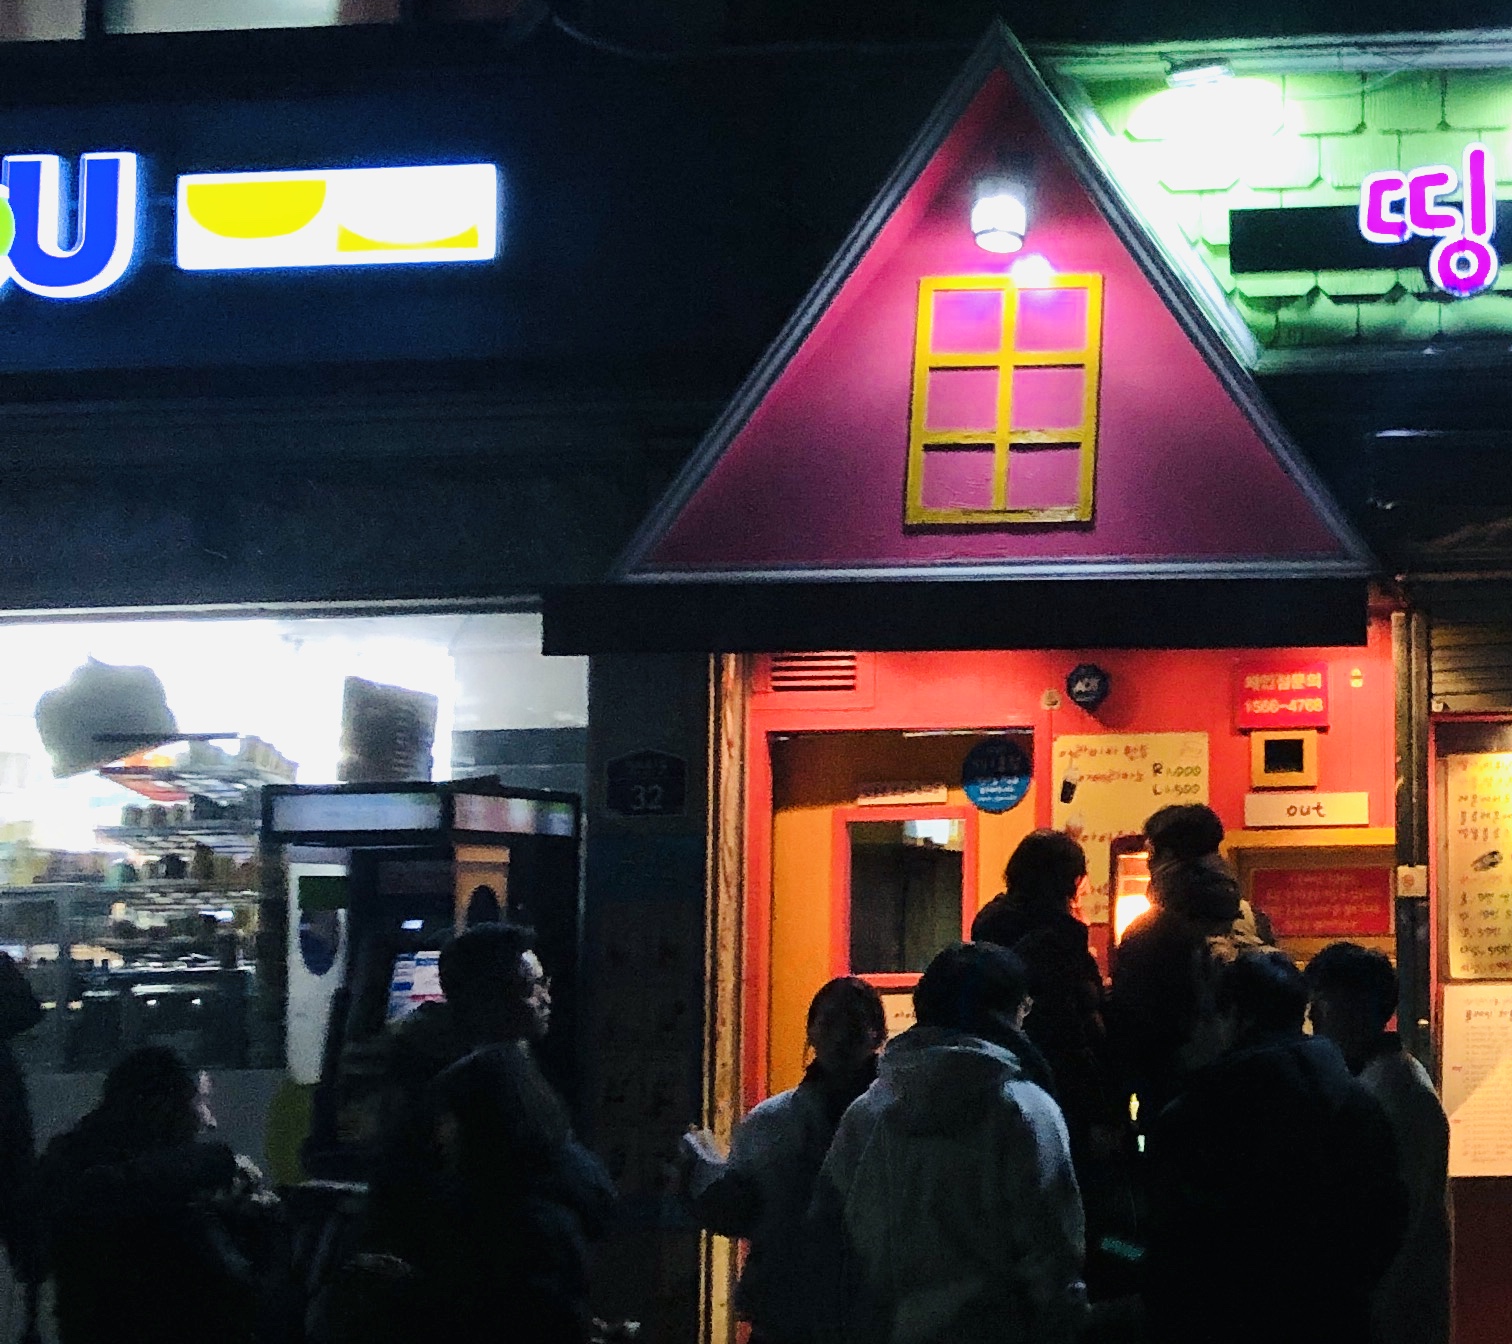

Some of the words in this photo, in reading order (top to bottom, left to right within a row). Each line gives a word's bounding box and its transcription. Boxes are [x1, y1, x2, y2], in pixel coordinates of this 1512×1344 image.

[0, 151, 137, 298] U
[630, 783, 664, 811] 32
[1286, 801, 1327, 818] out
